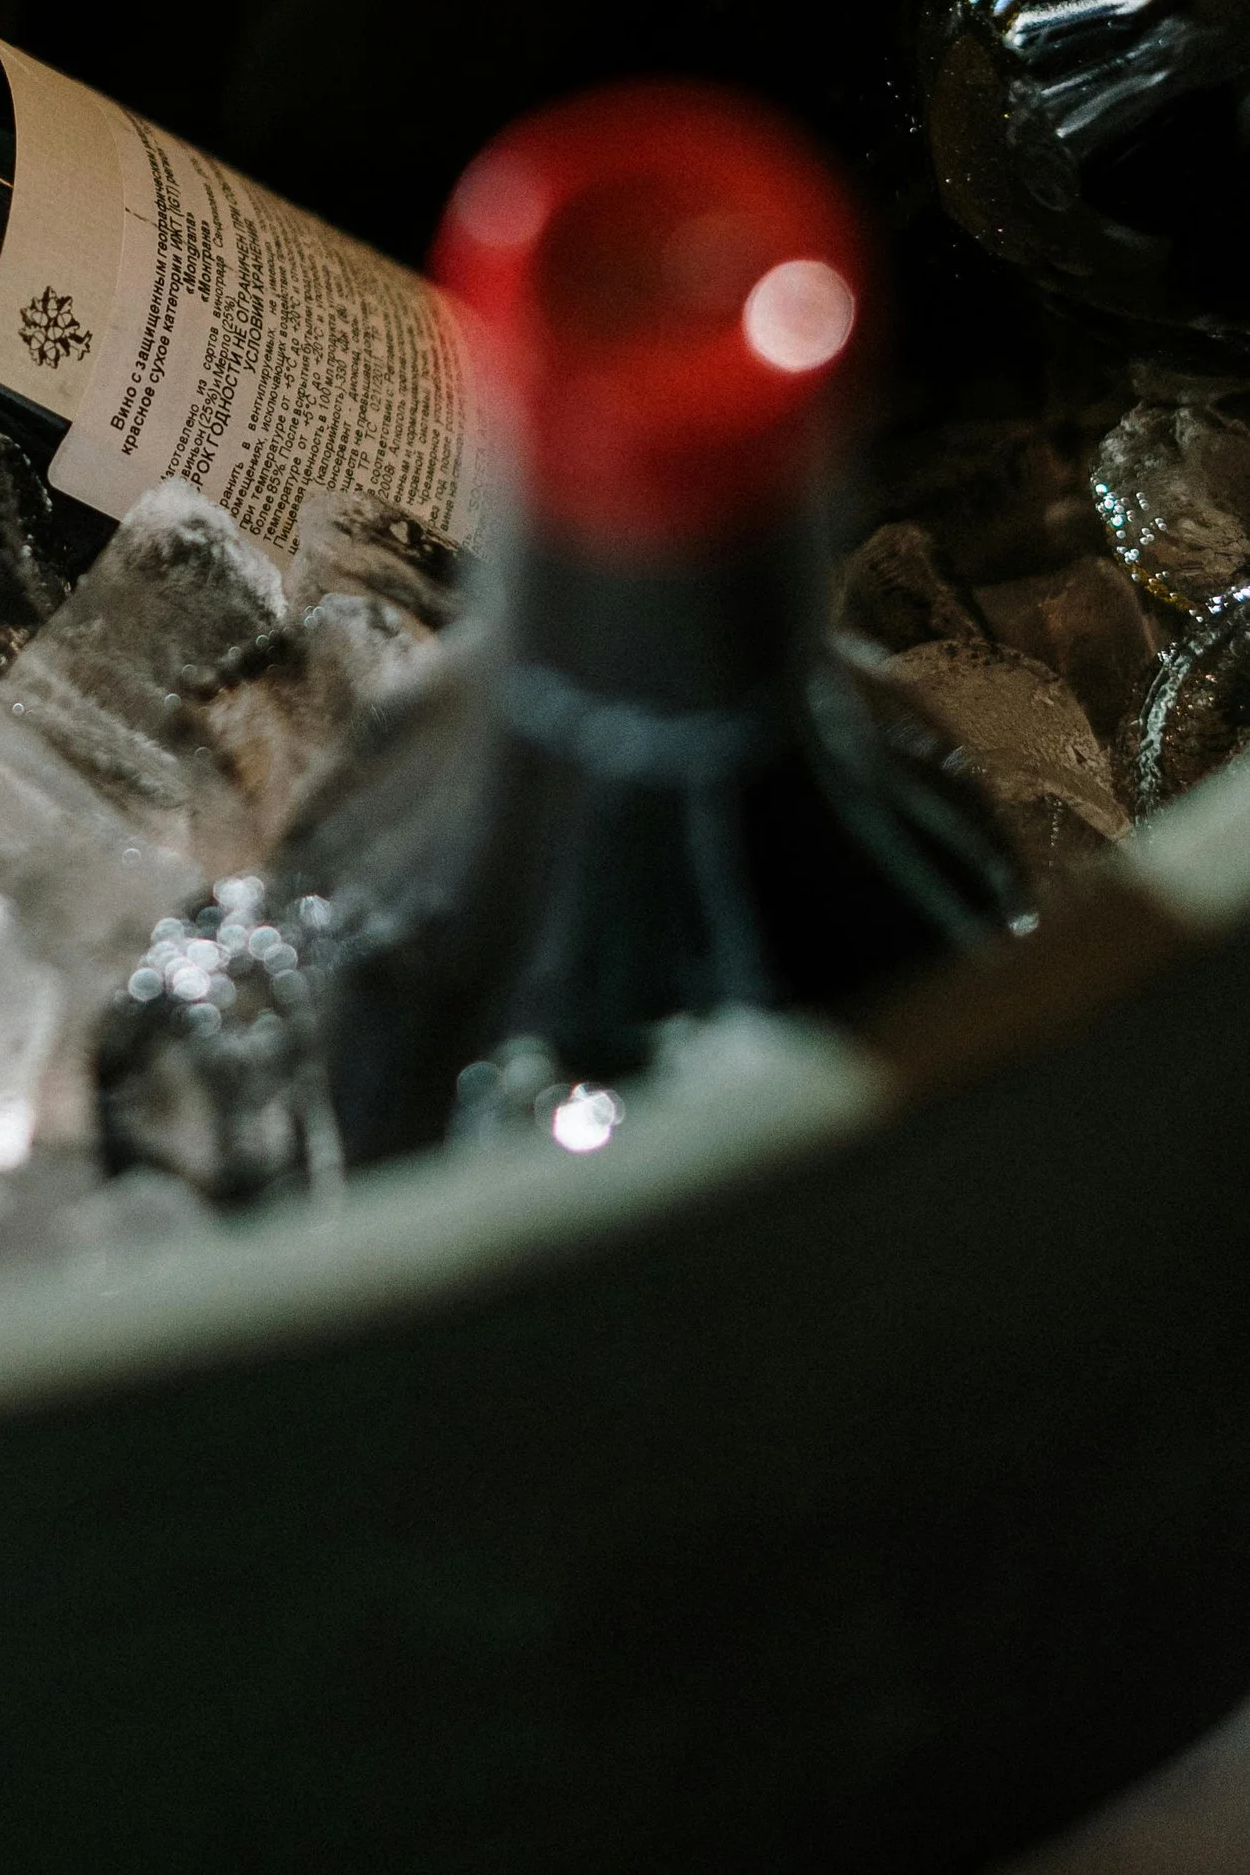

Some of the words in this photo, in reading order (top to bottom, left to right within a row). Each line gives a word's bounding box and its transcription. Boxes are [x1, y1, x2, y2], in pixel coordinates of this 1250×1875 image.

[140, 146, 172, 262] географическим
[169, 215, 182, 251] ИЖТ
[182, 207, 199, 297] «Mongrana»
[197, 215, 214, 306] «Монграна»
[234, 230, 250, 325] ОГРАНИЧЕН
[242, 215, 264, 294] ХРАНЕНИЯ
[134, 257, 168, 372] защищенным
[162, 252, 185, 335] категории
[195, 377, 207, 396] из
[202, 325, 221, 373] сортов
[212, 253, 226, 320] винограда
[232, 324, 247, 350] НЕ
[240, 291, 264, 374] УСЛОВИЙ
[300, 303, 315, 357] бутылки
[130, 370, 142, 384] с
[148, 333, 173, 387] сухое
[212, 331, 233, 380] Мерло
[212, 376, 222, 389] и
[292, 353, 313, 418] вскрытия
[324, 367, 334, 388] мл
[109, 382, 137, 431] Вино
[197, 385, 221, 430] (25%)
[205, 350, 245, 449] ГОДНОСТИ
[214, 458, 246, 515] ранить
[241, 439, 251, 450] в
[269, 297, 277, 316] не
[260, 339, 289, 434] исключающих
[317, 384, 332, 411] 100
[356, 357, 374, 430] превышает
[120, 384, 159, 458] красное
[239, 503, 259, 532] при
[251, 414, 289, 503] температуре
[281, 394, 291, 411] от
[291, 336, 301, 356] до
[278, 414, 300, 460] После
[317, 412, 327, 423] в
[353, 428, 363, 446] не
[369, 397, 393, 485] соответствии
[388, 396, 406, 458] Алкоголь
[176, 428, 206, 486] виньон
[262, 455, 304, 544] температуре
[297, 433, 308, 450] от
[311, 370, 322, 390] до
[299, 422, 327, 487] ценность
[324, 419, 354, 495] онсервант
[339, 446, 362, 495] ществ
[392, 457, 410, 503] енным
[403, 447, 412, 458] и
[402, 446, 426, 506] нервной
[416, 426, 443, 509] Чрезмерное
[438, 434, 452, 474] после
[248, 492, 275, 536] более
[272, 483, 308, 550] Пищевая
[366, 486, 375, 495] в
[425, 502, 443, 531] рез
[433, 475, 447, 501] год
[439, 498, 455, 532] вина
